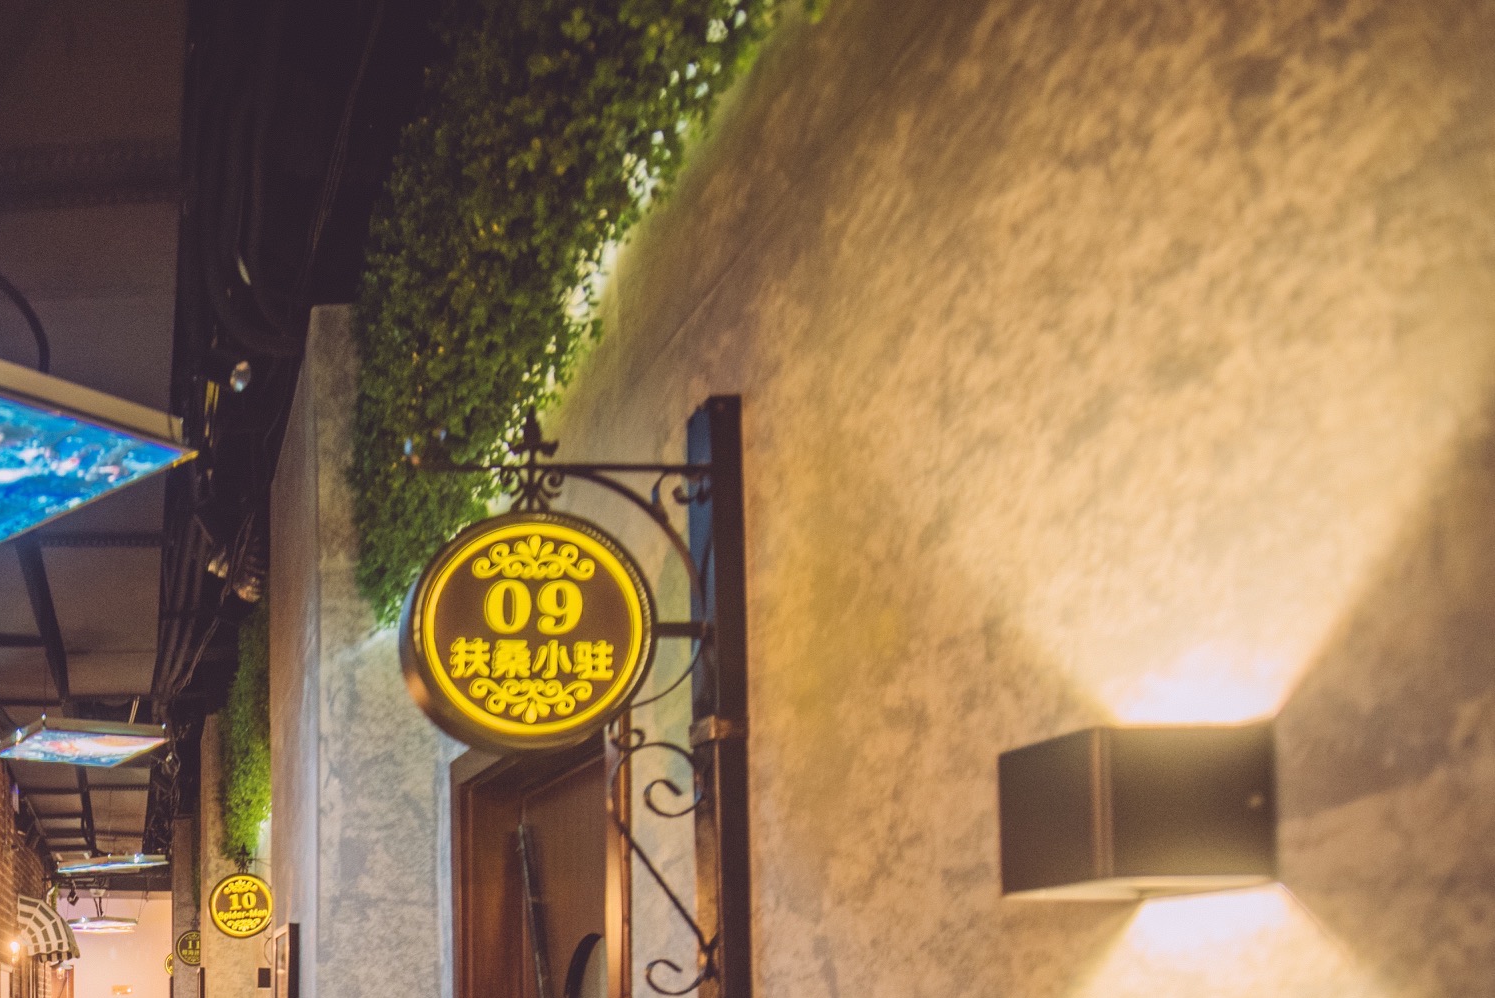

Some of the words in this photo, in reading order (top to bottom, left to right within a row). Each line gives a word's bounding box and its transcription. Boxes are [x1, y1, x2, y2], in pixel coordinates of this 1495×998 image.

[485, 579, 583, 635] 09
[450, 637, 613, 681] 扶桑小驻
[229, 892, 256, 911] 10
